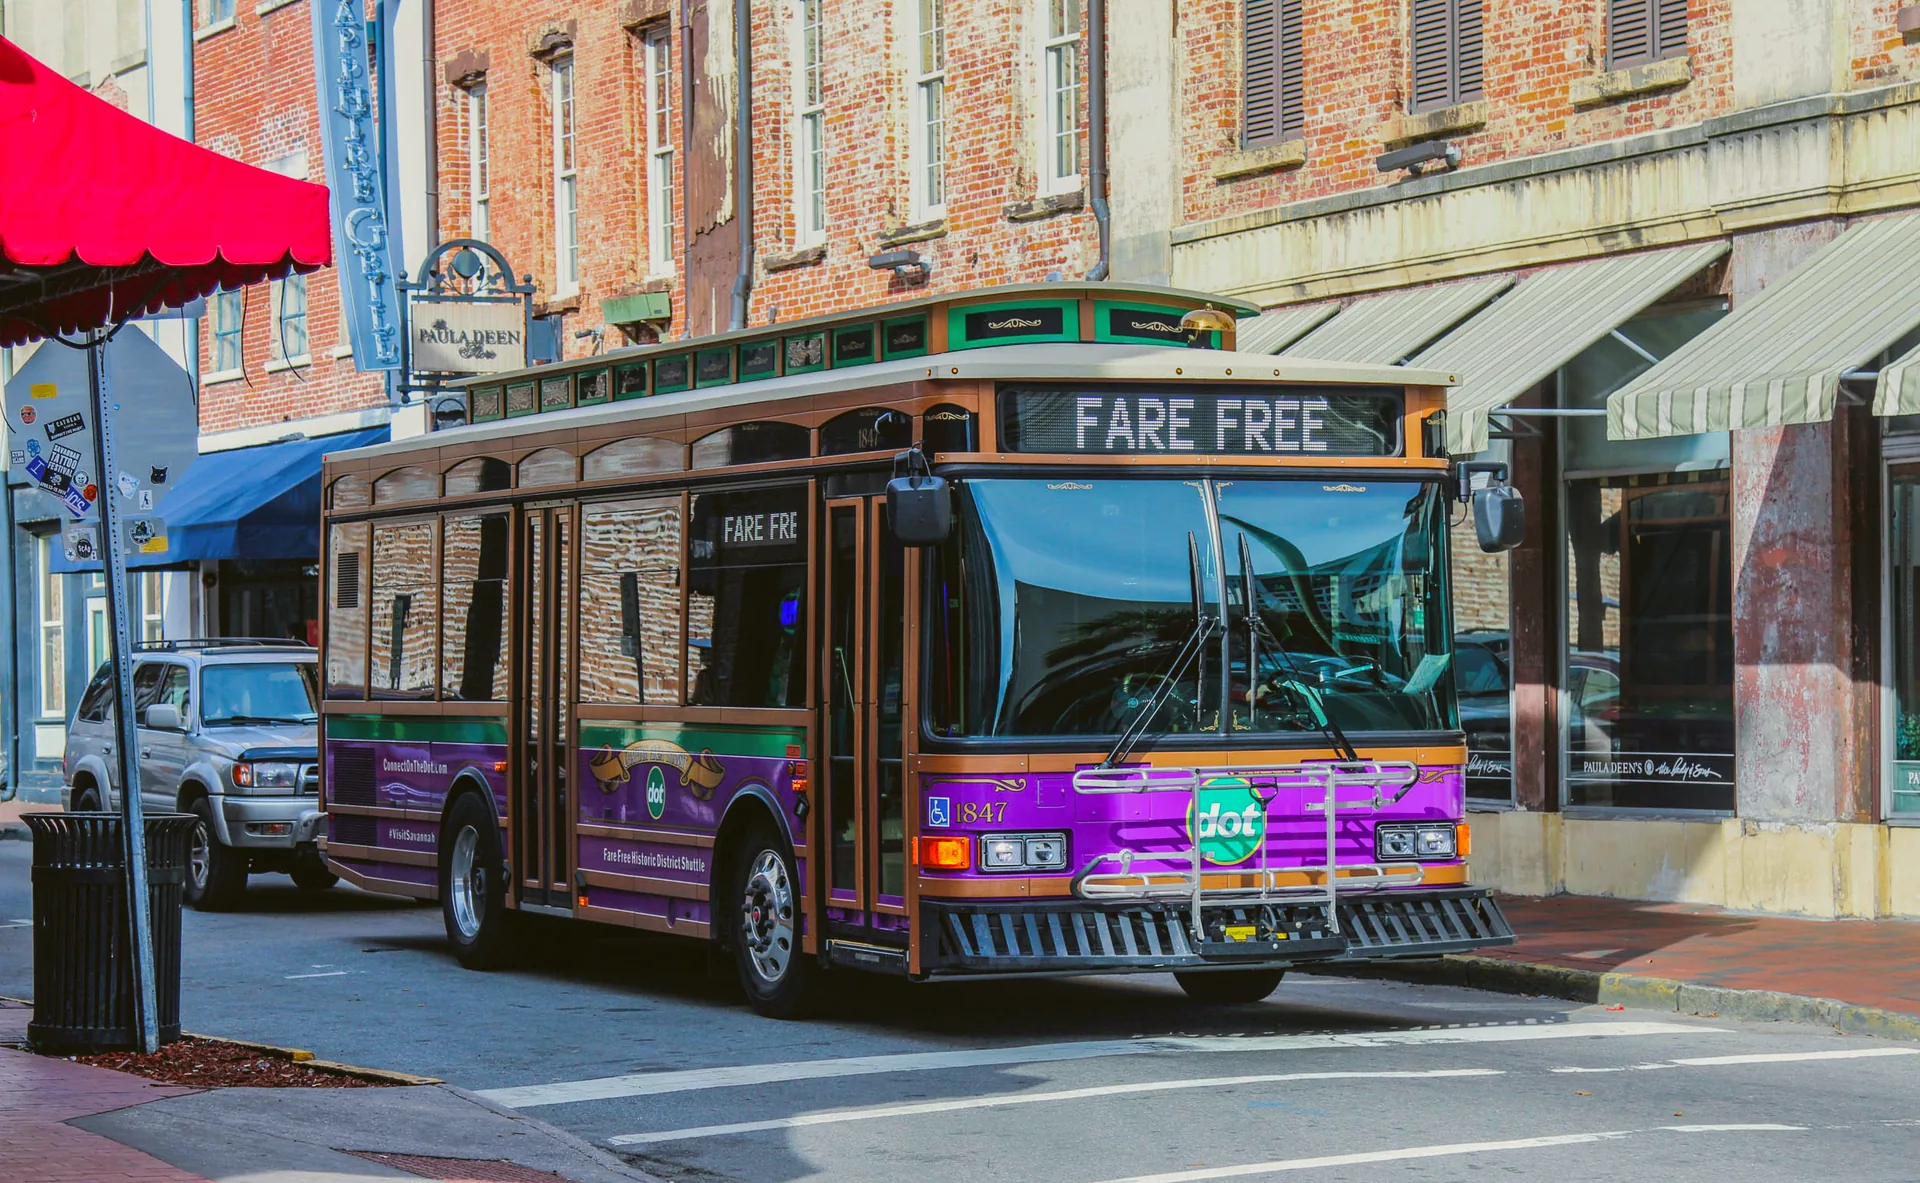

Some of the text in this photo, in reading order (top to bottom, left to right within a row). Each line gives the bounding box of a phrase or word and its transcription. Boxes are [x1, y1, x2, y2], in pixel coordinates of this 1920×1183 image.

[344, 207, 396, 360] GRILL
[420, 328, 521, 345] PAULA DEEN
[1076, 397, 1328, 451] FARE FREE
[50, 451, 78, 470] TATTOO
[53, 445, 80, 460] SAVANNAH
[47, 461, 73, 477] FESTIVAL
[724, 514, 764, 542] FARE
[383, 758, 448, 774] ConnectOnTheDot.com
[1584, 761, 1608, 773] PAULA
[1611, 762, 1643, 774] DEEN'S
[648, 782, 664, 804] dot
[955, 802, 1008, 824] 1847
[1198, 803, 1262, 838] dot
[389, 828, 436, 843] #VisitSavannah
[603, 847, 706, 873] Fare Free Historic District Shuttle
